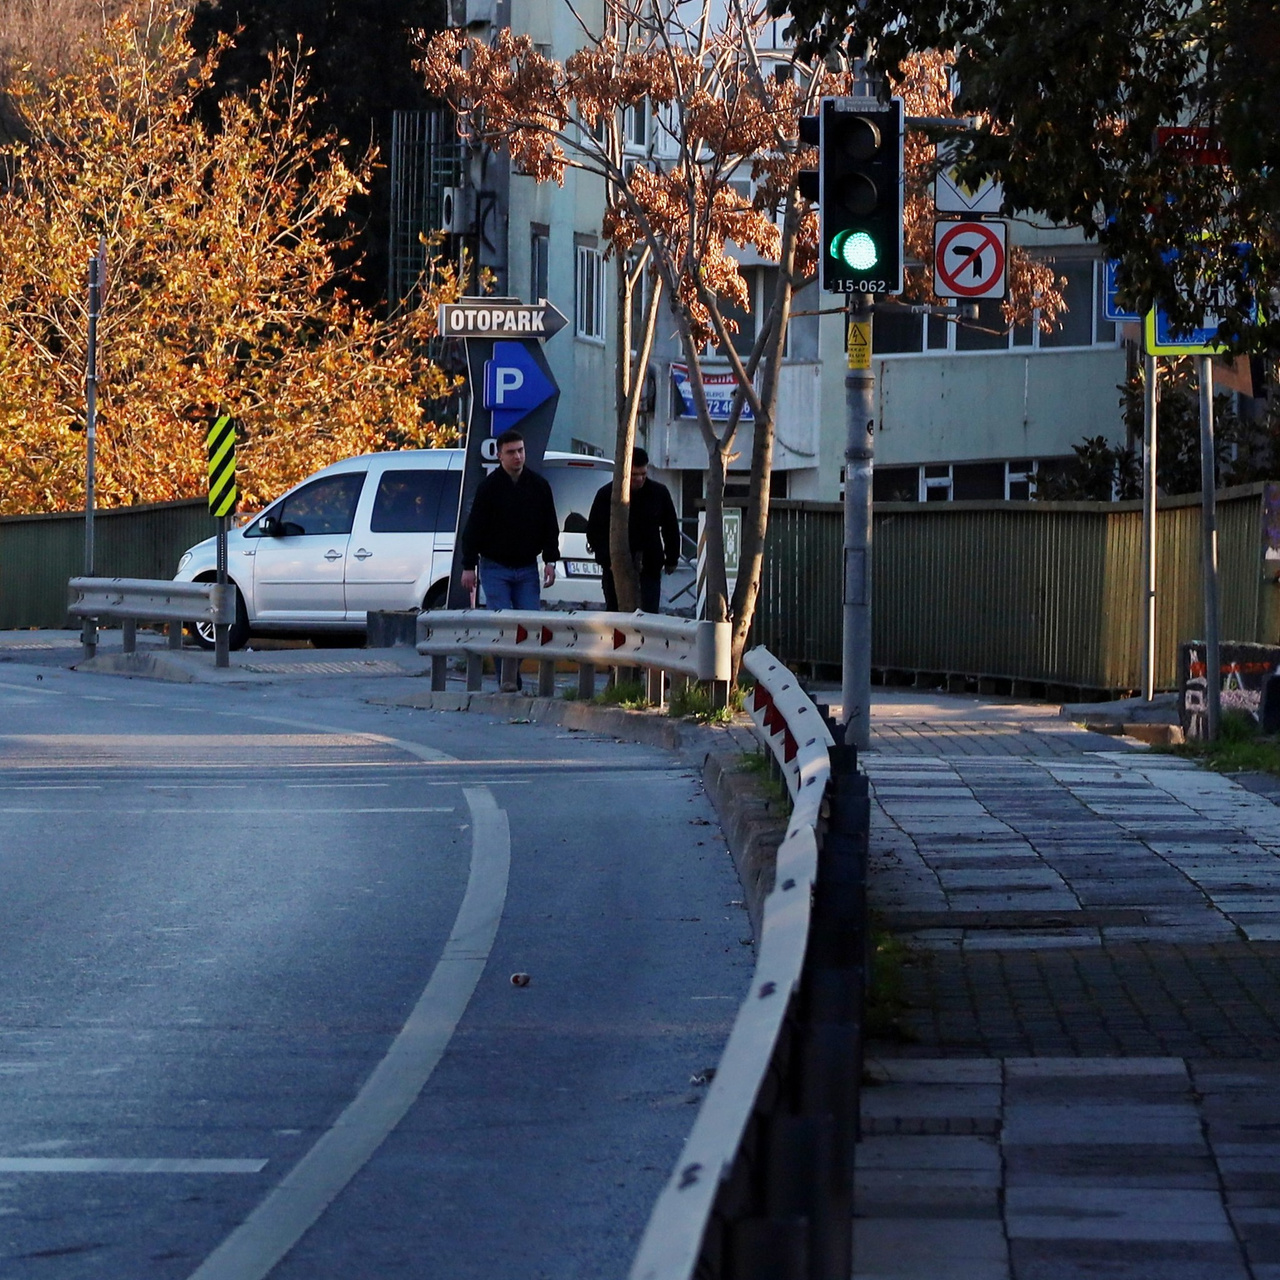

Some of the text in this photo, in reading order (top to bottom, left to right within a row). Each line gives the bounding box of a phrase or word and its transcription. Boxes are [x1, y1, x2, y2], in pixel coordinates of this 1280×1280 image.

[837, 279, 886, 293] 15-062
[450, 309, 546, 332] OTOPARK
[495, 367, 524, 404] P
